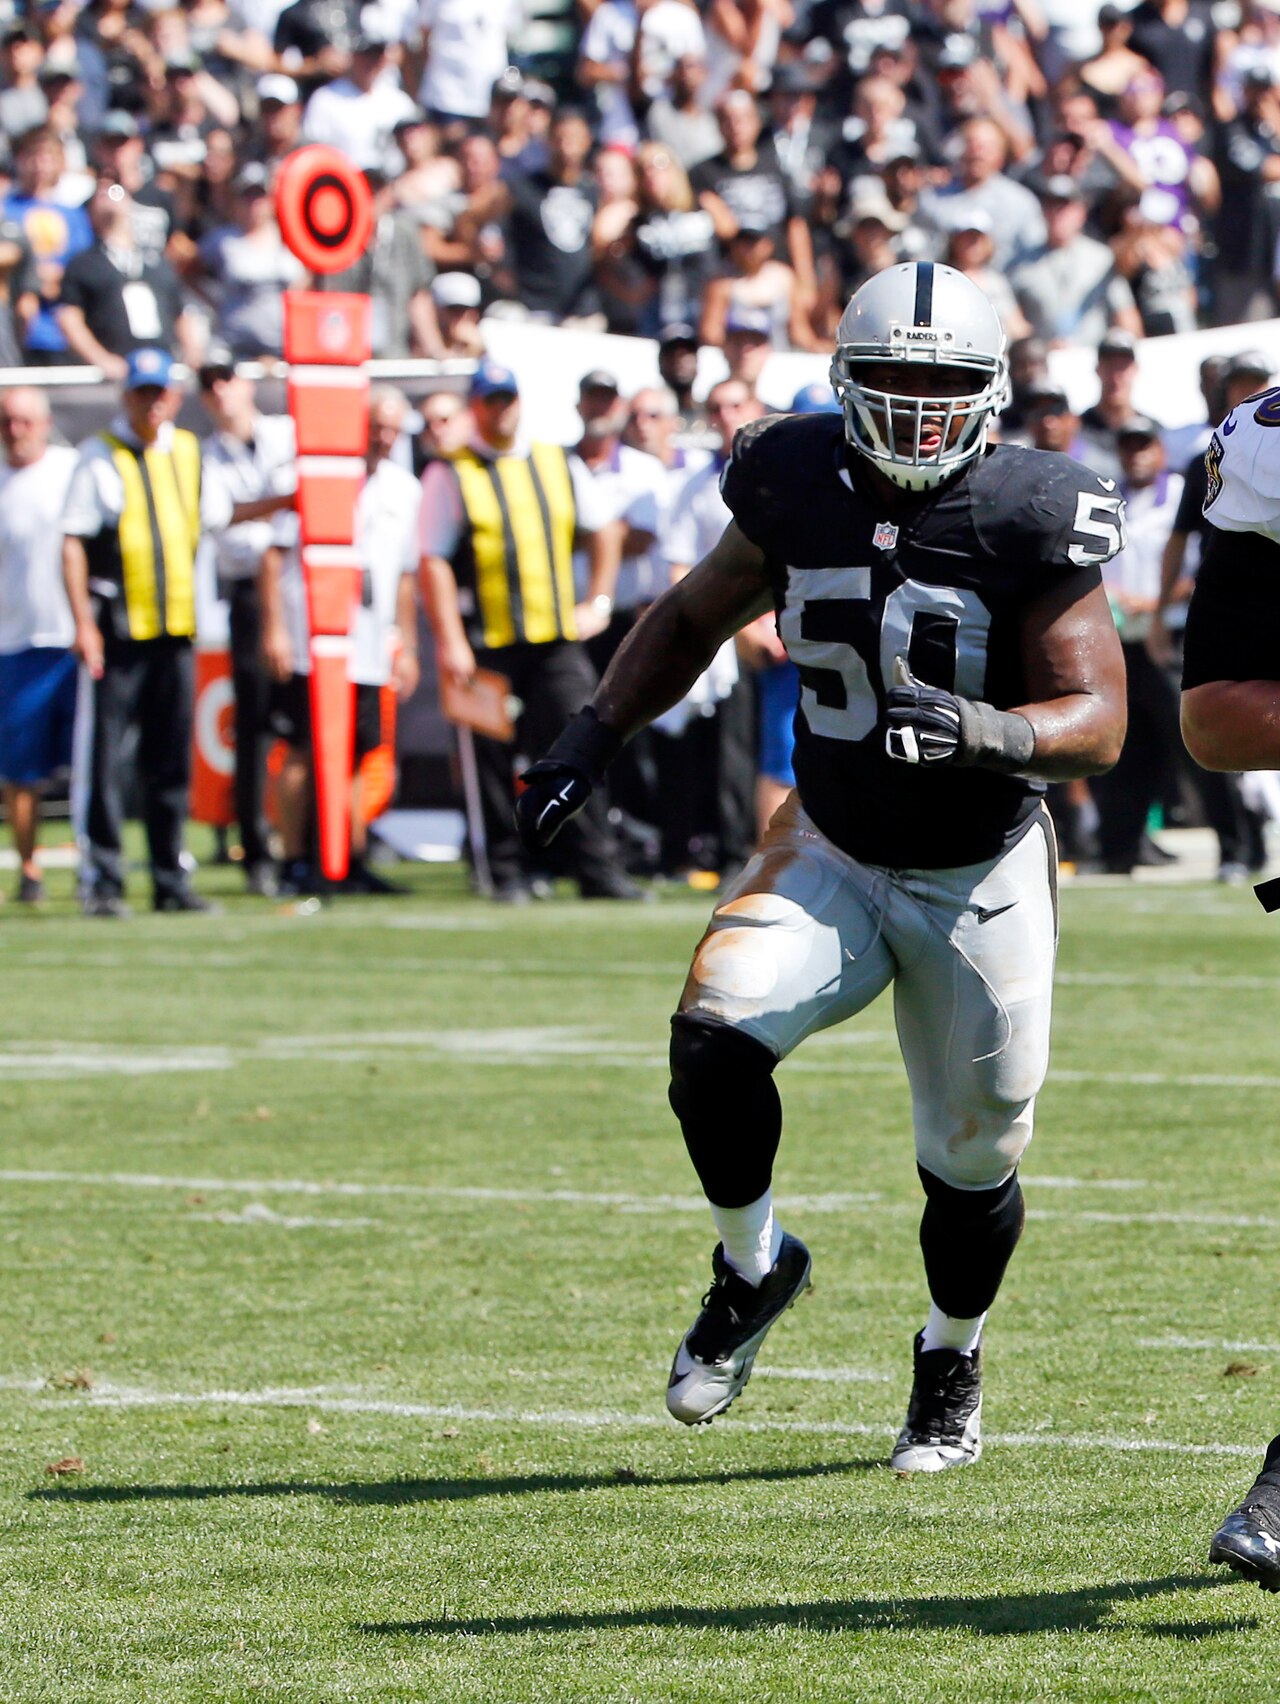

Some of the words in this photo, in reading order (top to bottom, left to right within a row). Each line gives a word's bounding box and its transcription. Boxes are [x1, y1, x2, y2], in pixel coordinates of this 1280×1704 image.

[906, 332, 937, 341] RAIDERS
[1067, 490, 1127, 566] 5
[779, 566, 992, 742] 50
